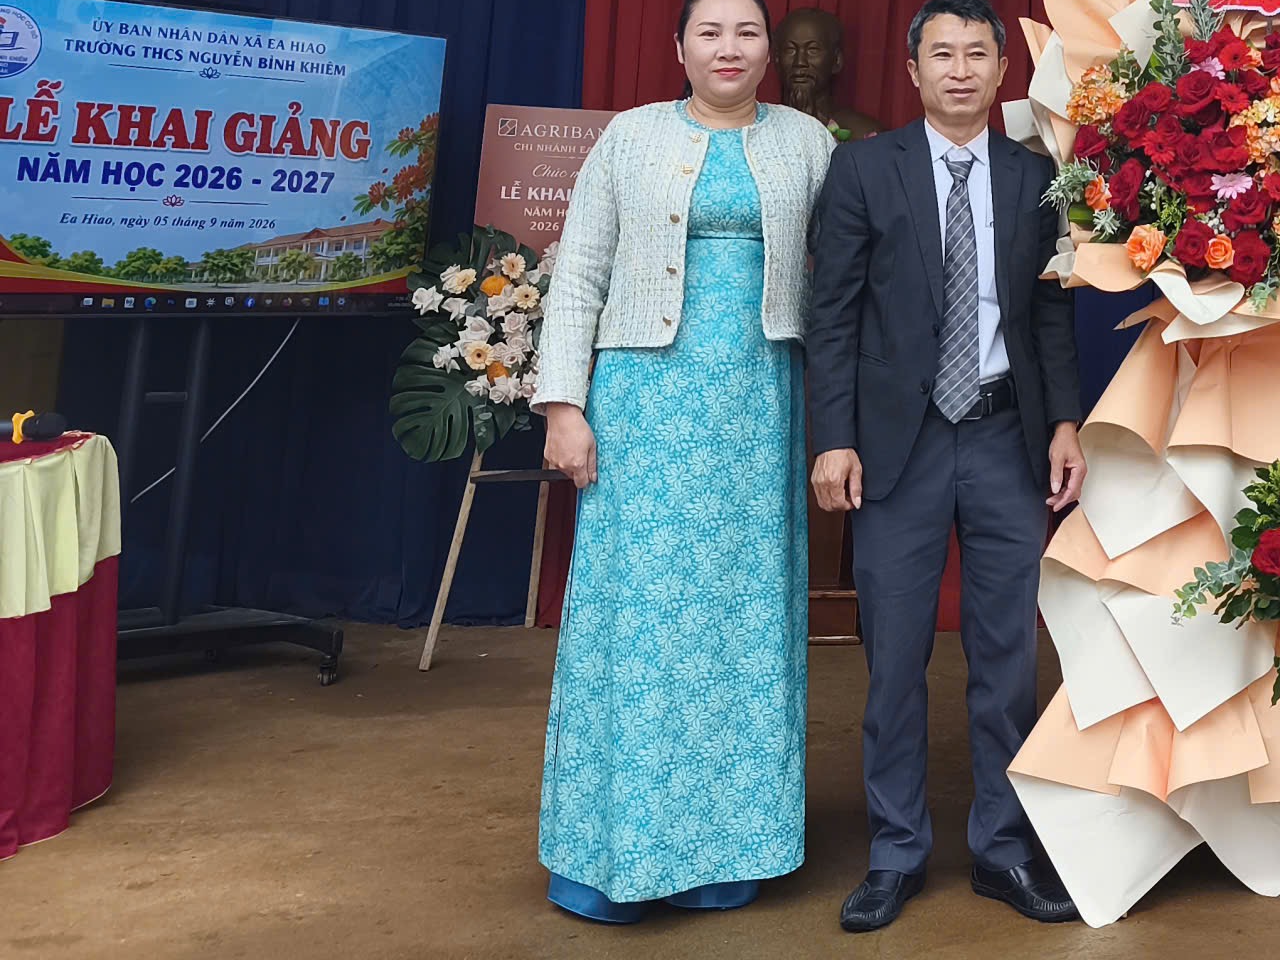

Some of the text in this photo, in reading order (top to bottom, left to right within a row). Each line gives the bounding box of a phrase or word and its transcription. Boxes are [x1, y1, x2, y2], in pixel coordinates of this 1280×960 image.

[119, 23, 151, 37] BAN
[157, 26, 202, 41] NHÂN
[207, 30, 239, 45] DÂN
[243, 35, 263, 48] XÃ
[268, 39, 285, 50] EA
[291, 41, 326, 54] HIAO
[64, 39, 136, 57] TRƯỜNG
[142, 45, 183, 61] THCS
[189, 50, 253, 67] NGUYỄN
[300, 61, 346, 76] KHIÊM
[0, 79, 372, 161] LỄ KHAI GIẢNG
[521, 124, 606, 139] AGRIBAN
[514, 143, 533, 151] CHI
[537, 144, 576, 153] NHÁNH
[17, 152, 91, 184] NĂM
[101, 161, 165, 192] HỌC
[175, 164, 242, 190] 2026
[271, 169, 335, 194] 2027
[532, 164, 567, 177] Chúc
[501, 180, 574, 201] LỄ KHAI
[59, 213, 276, 229] Ea Hiao, ngày 05 tháng 9 năm 2026
[530, 222, 559, 231] 2026
